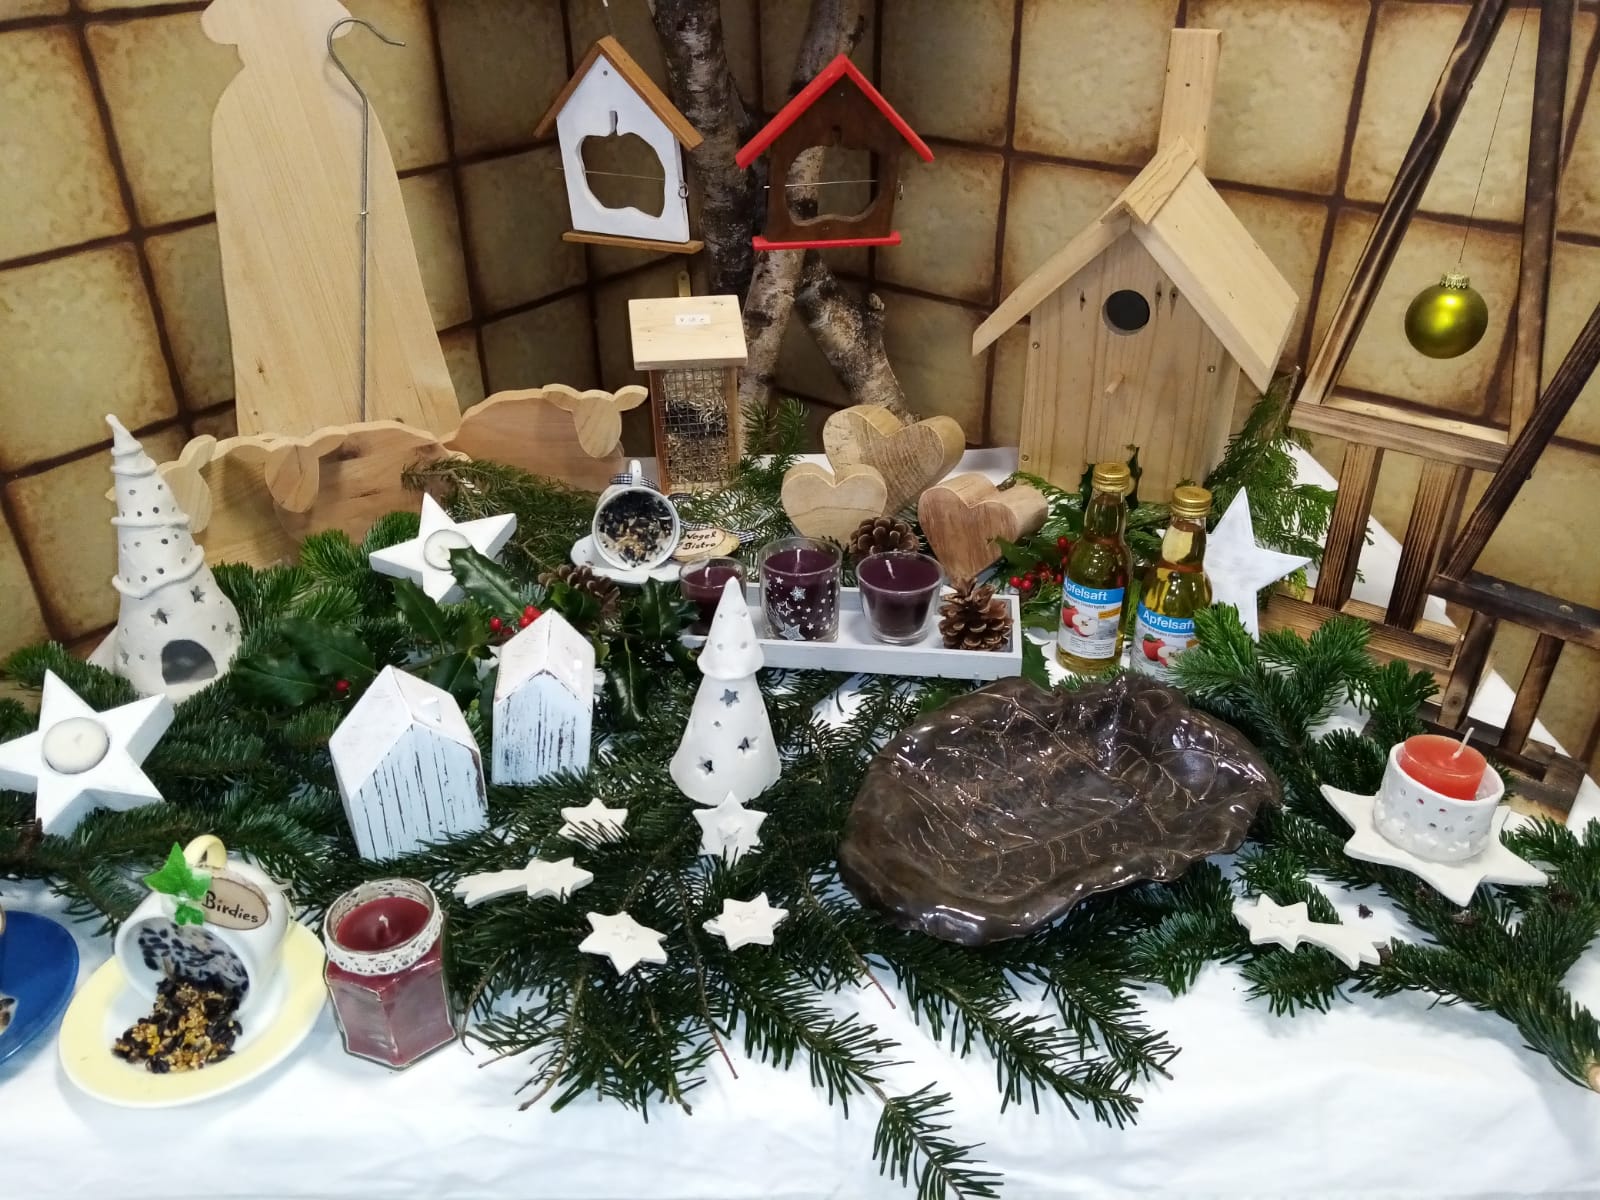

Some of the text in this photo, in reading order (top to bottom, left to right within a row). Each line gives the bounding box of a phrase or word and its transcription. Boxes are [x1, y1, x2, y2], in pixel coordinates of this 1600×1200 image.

[686, 530, 717, 541] Vogel
[682, 542, 716, 550] Bistro
[201, 890, 259, 923] Birdies
